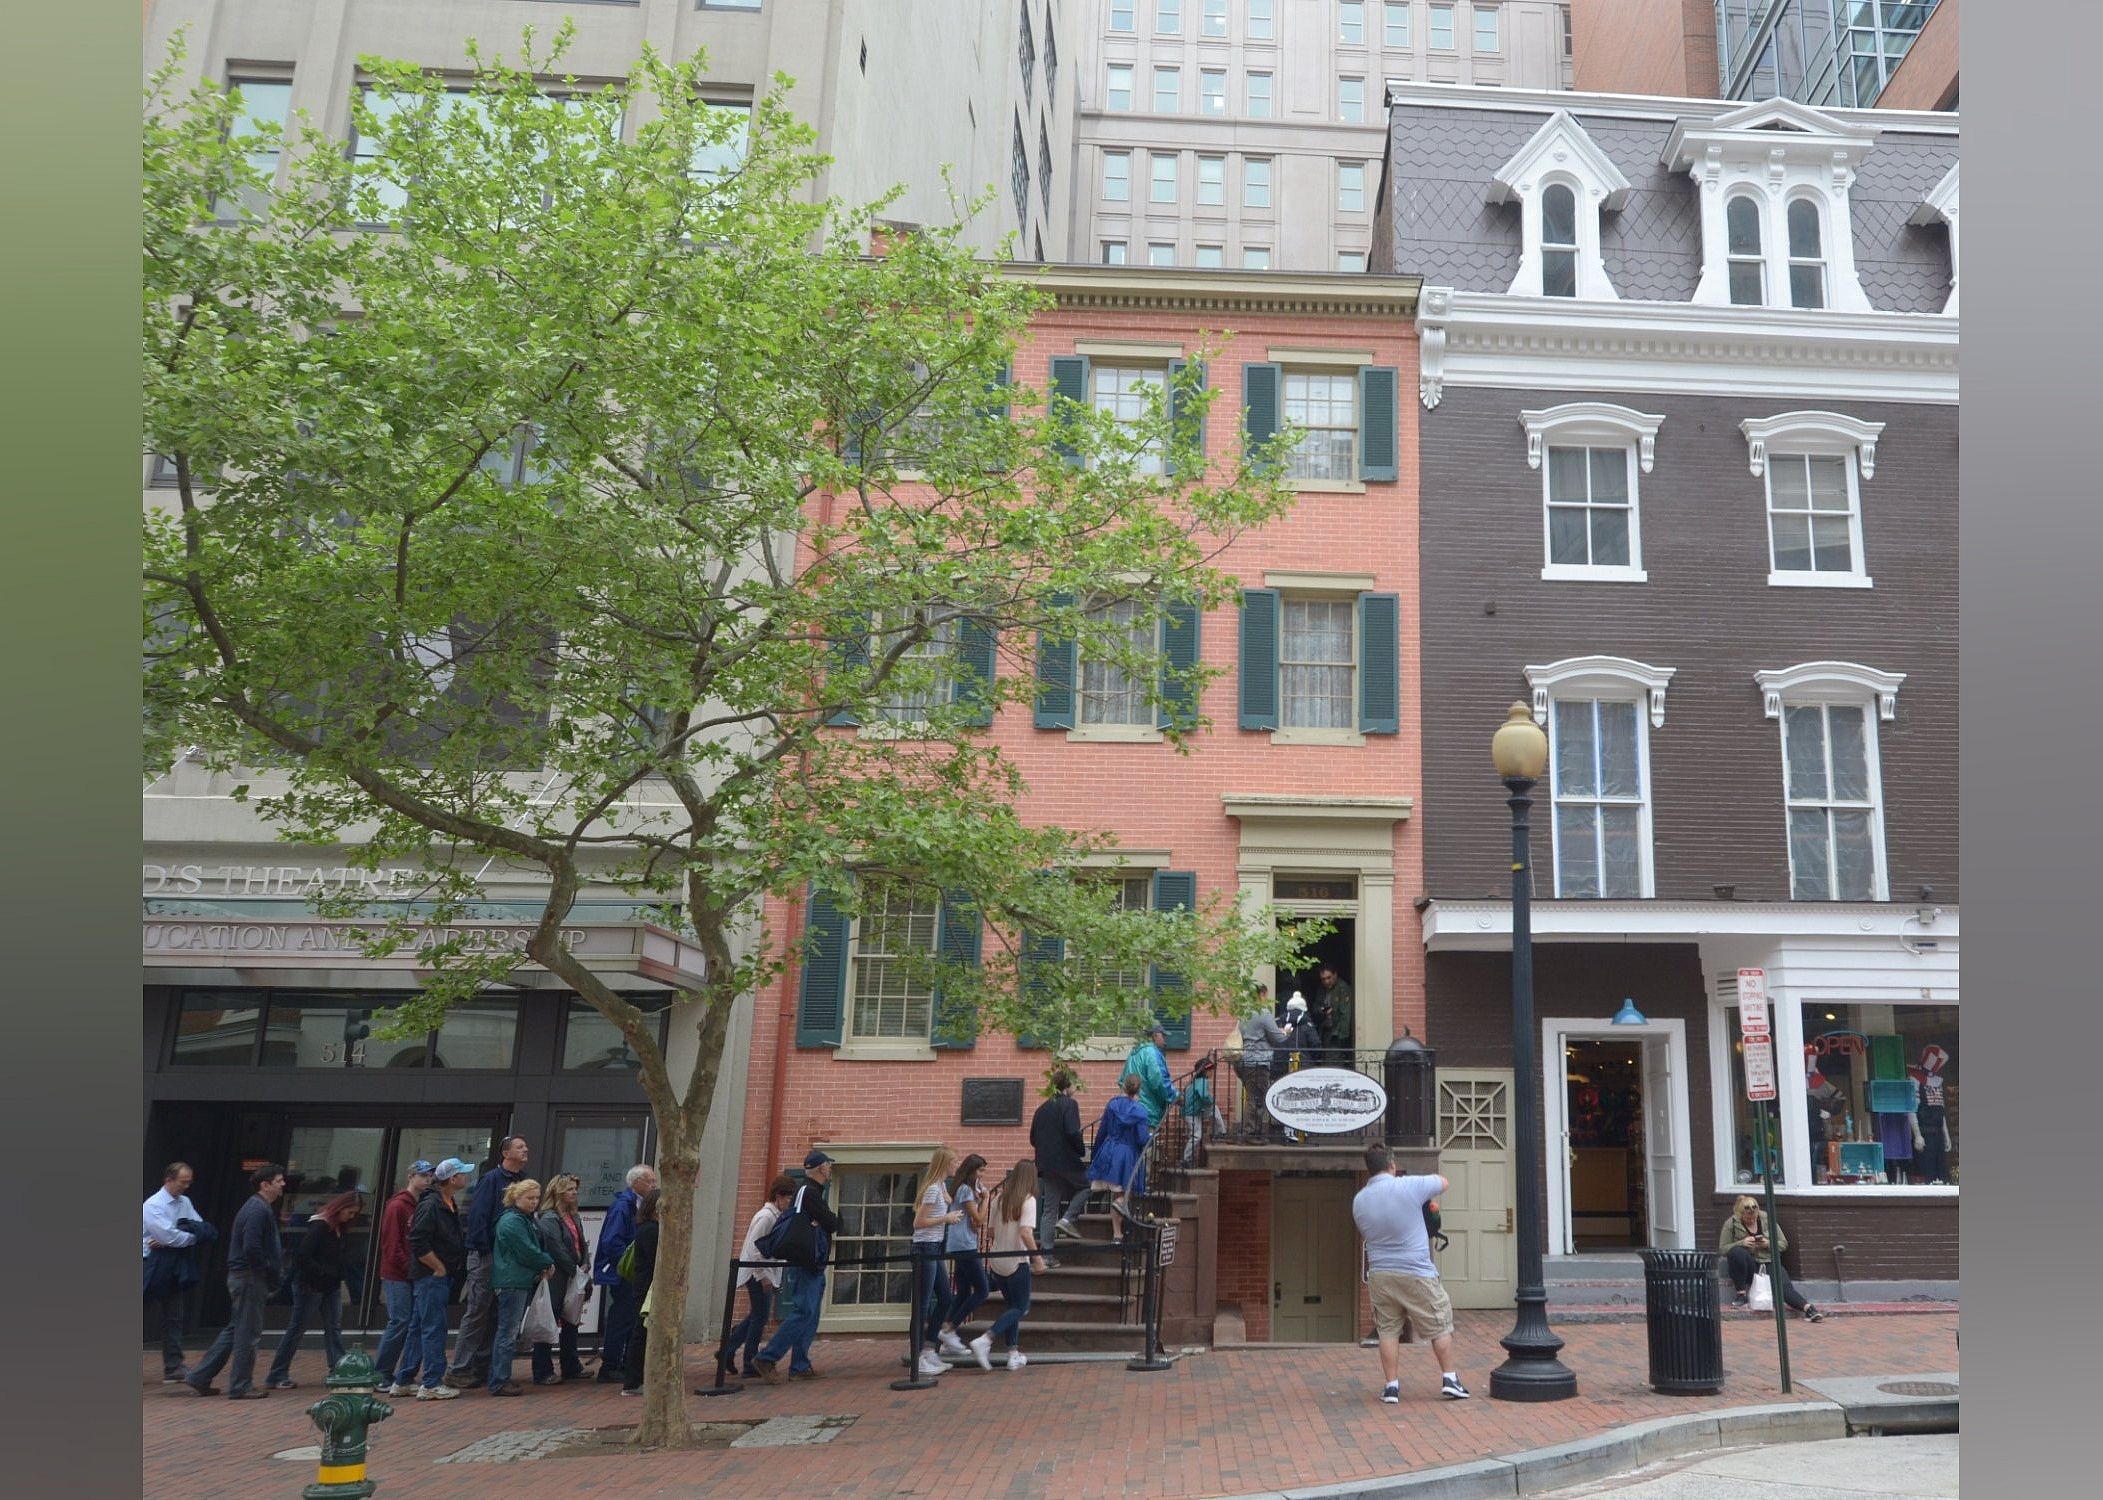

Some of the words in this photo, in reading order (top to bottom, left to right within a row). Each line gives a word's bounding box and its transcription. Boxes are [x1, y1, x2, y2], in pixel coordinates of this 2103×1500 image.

[217, 865, 413, 897] THEATRE
[380, 927, 586, 953] EADERSIP
[320, 1041, 367, 1064] 514
[1815, 1035, 1867, 1056] OPEN
